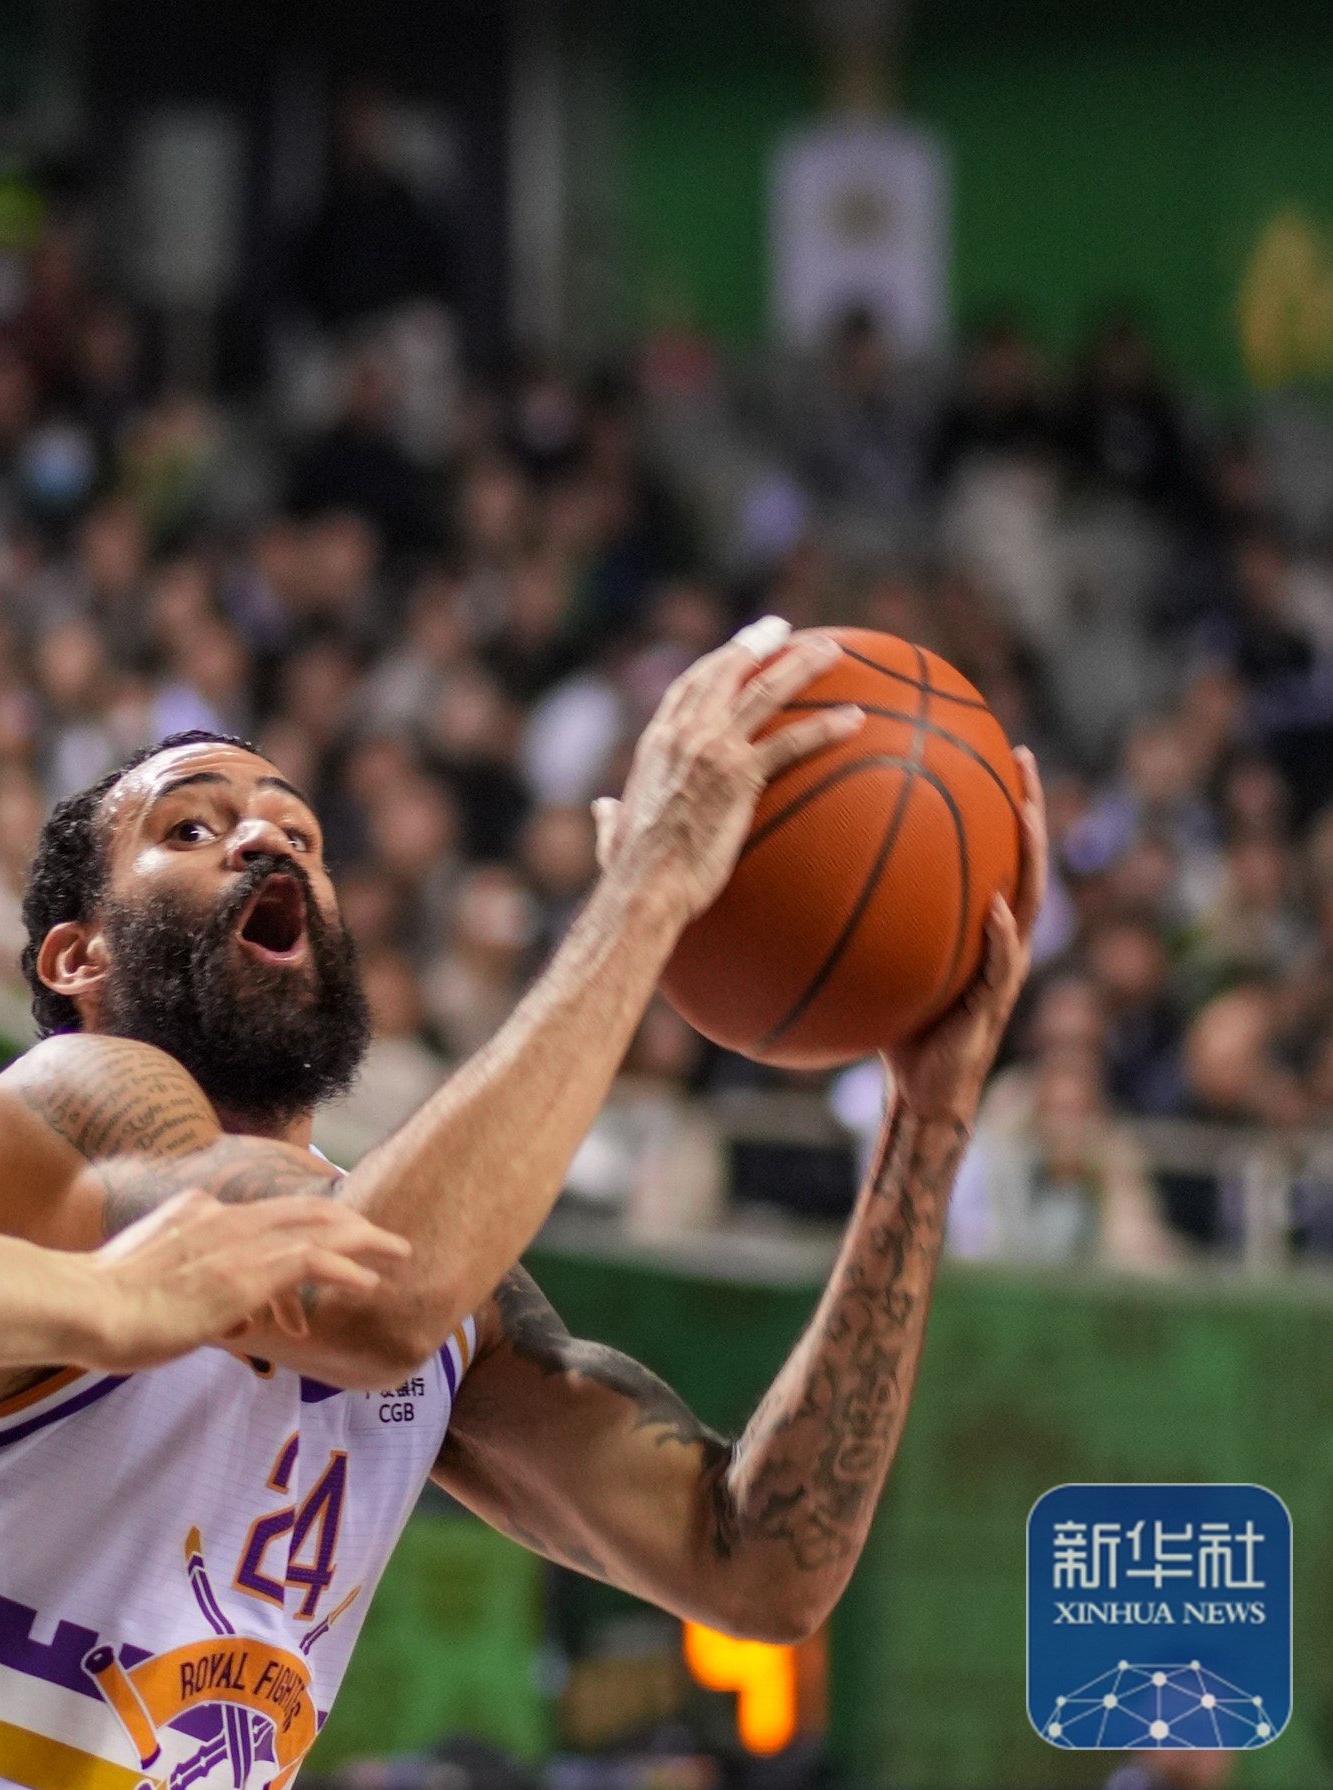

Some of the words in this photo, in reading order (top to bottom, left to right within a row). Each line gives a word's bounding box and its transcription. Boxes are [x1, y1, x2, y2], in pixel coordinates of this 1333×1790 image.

[378, 1402, 415, 1423] CGB
[232, 1431, 349, 1620] 24
[180, 1652, 249, 1700] ROYAL
